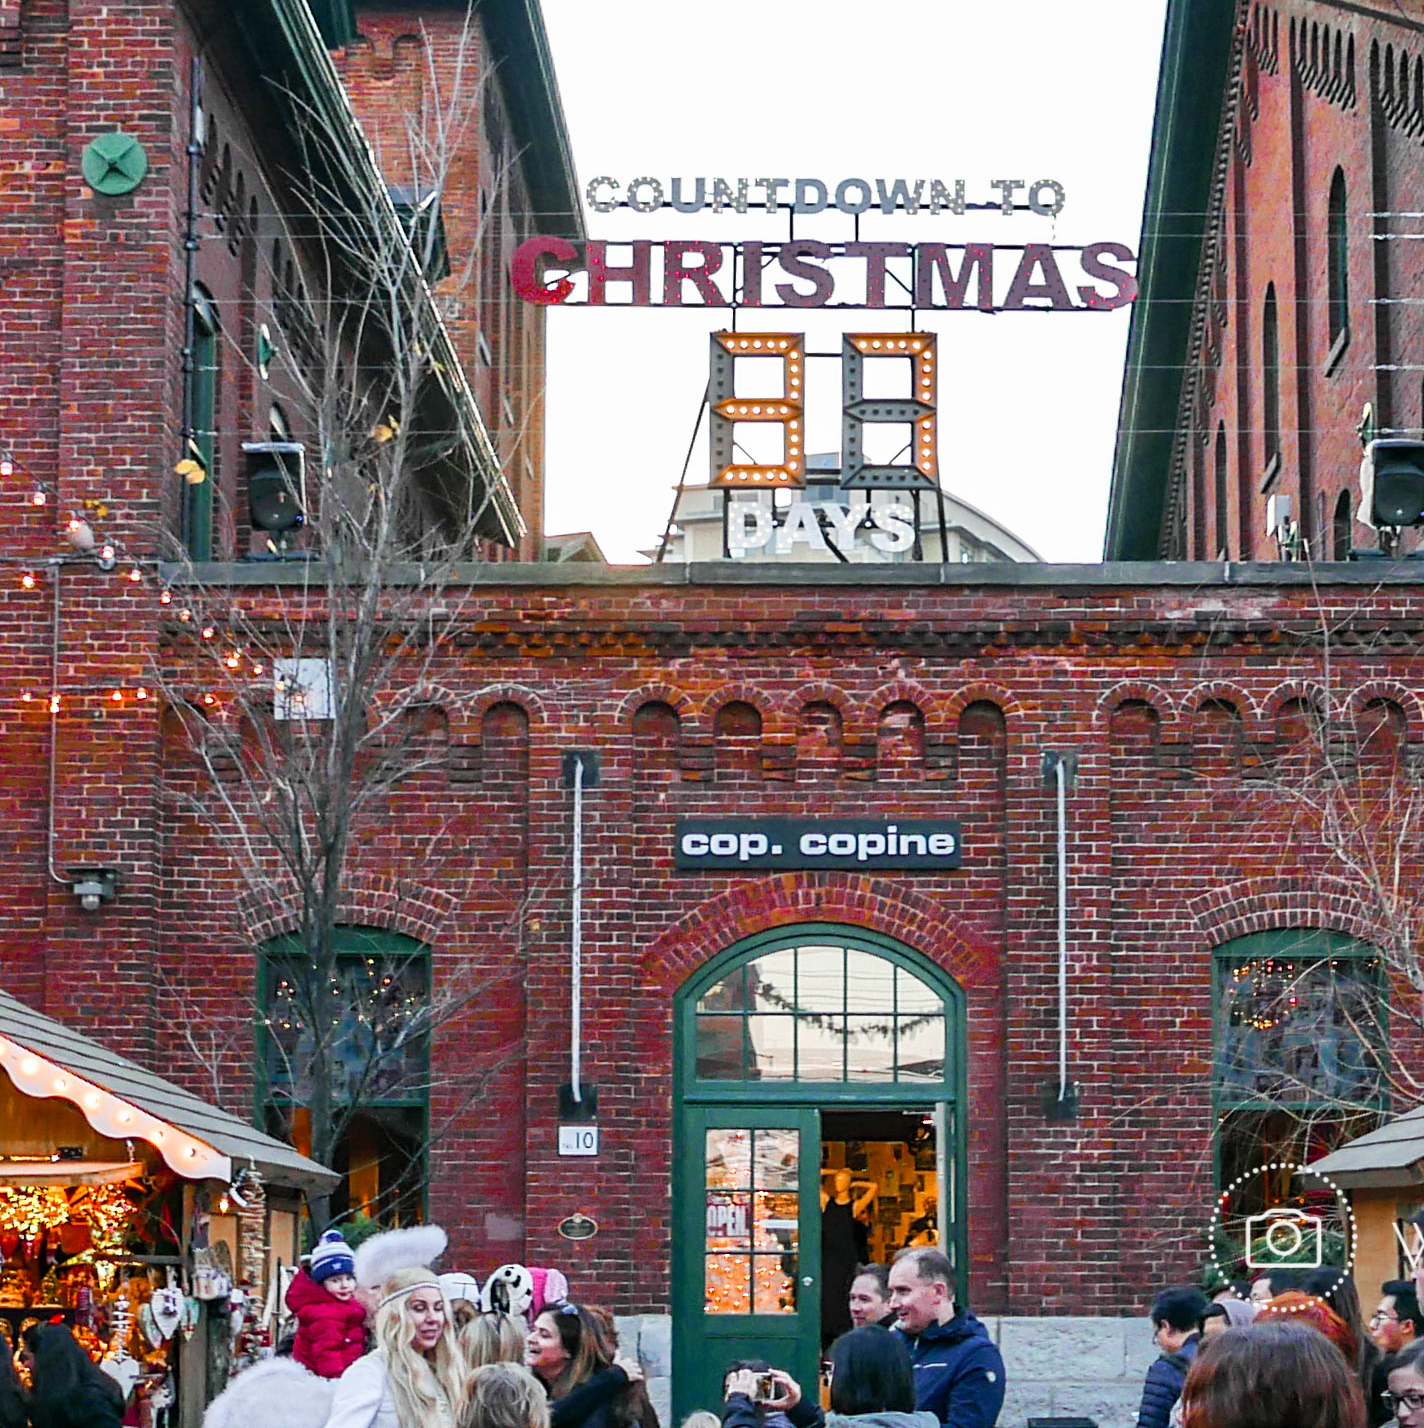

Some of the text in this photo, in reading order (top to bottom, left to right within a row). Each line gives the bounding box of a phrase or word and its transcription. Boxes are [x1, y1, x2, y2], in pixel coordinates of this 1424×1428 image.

[586, 176, 1066, 216] COUNTDOWN TO
[511, 236, 1138, 310] CHRISTMAS
[726, 501, 916, 553] DAYS
[681, 825, 956, 861] cop. copine
[576, 1132, 594, 1149] 10
